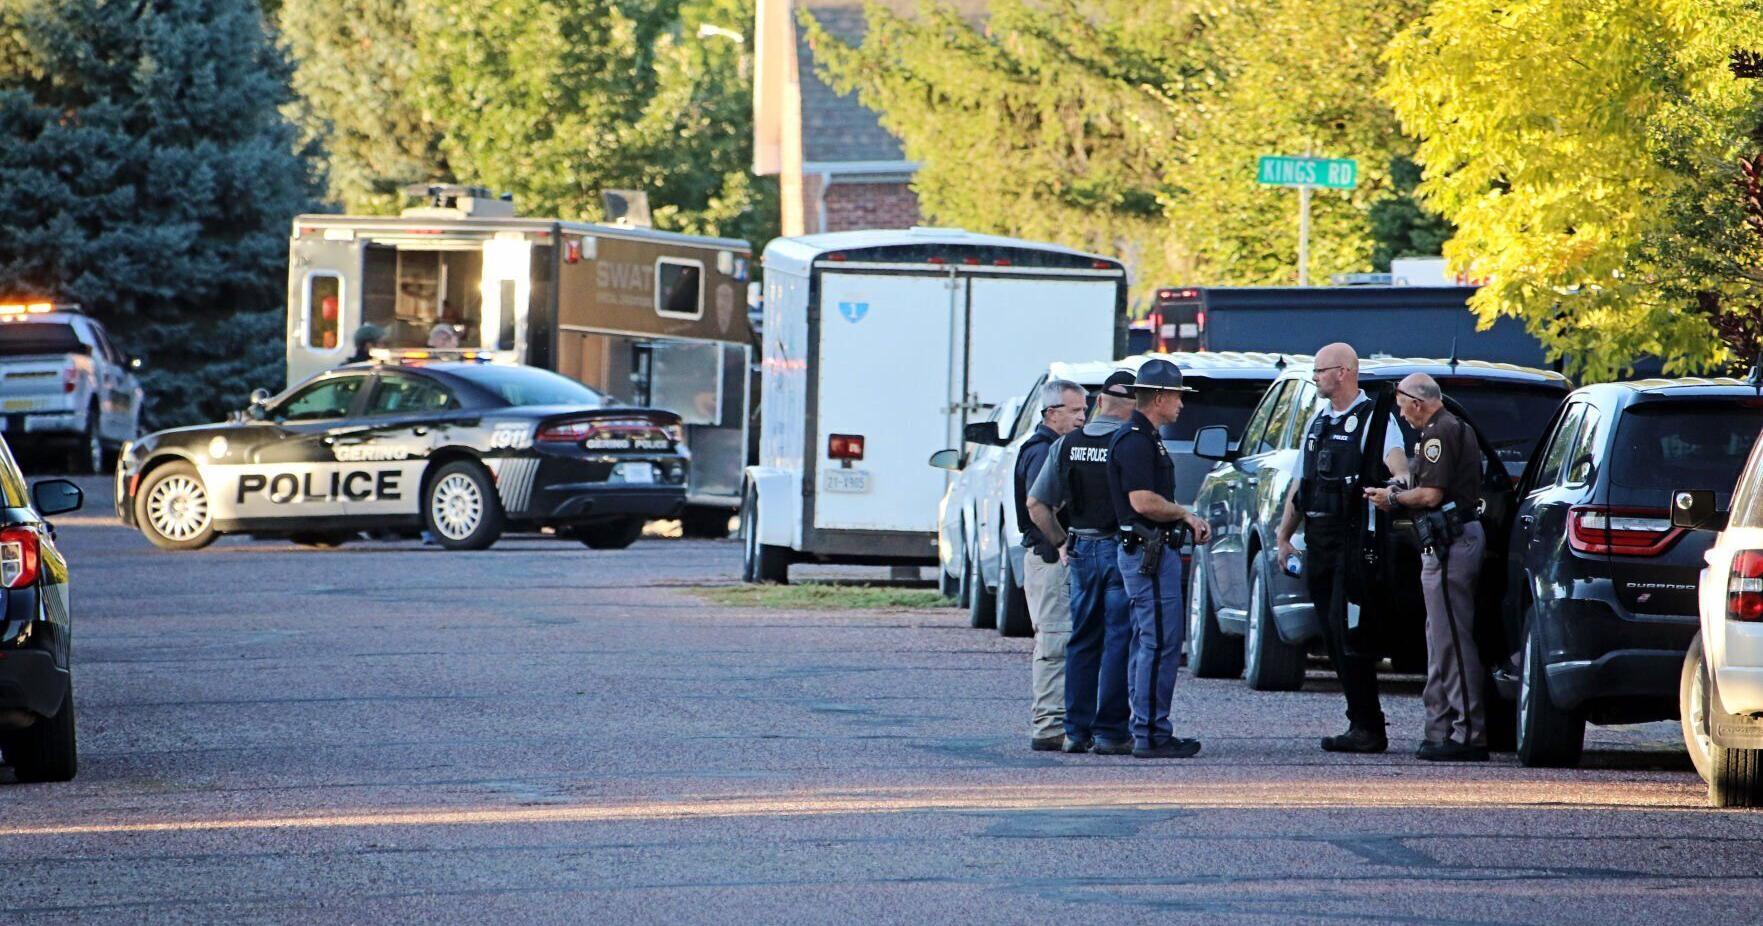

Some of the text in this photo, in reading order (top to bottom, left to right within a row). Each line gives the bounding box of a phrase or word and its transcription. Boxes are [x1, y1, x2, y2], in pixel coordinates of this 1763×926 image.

[1263, 160, 1352, 185] KINGS RD
[596, 261, 654, 291] SWAT
[336, 444, 409, 462] GERING
[634, 439, 669, 449] POLICE
[1070, 446, 1108, 462] STATE POLICE
[236, 470, 402, 504] POLICE
